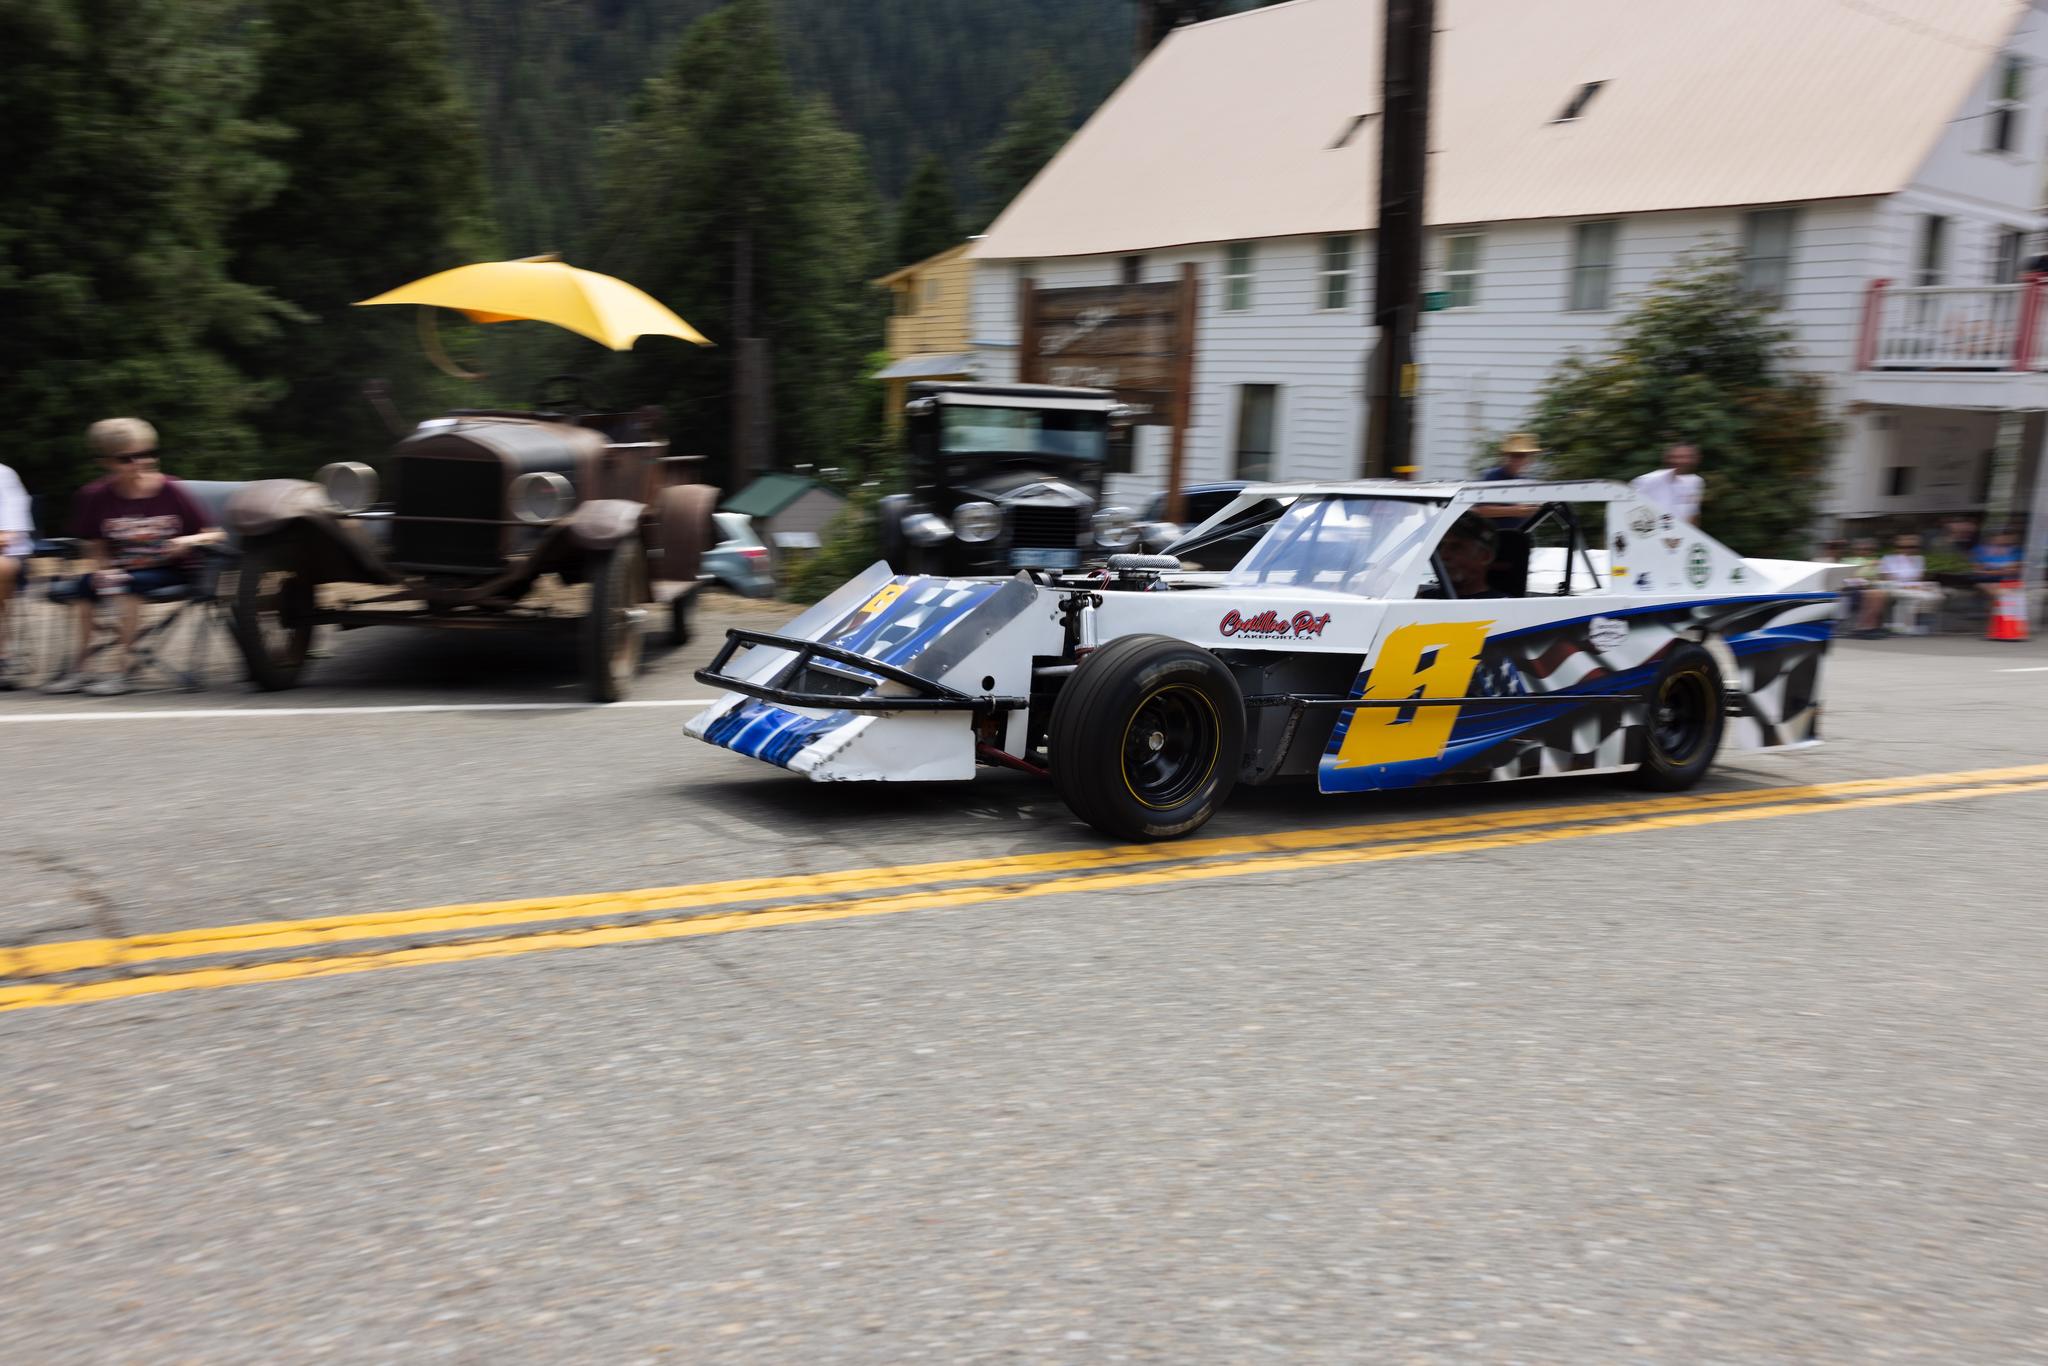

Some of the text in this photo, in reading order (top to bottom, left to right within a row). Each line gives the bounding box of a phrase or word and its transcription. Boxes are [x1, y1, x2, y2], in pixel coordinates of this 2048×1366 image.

[860, 583, 910, 613] 8
[1220, 609, 1291, 636] Cadillac
[1333, 620, 1496, 769] 8
